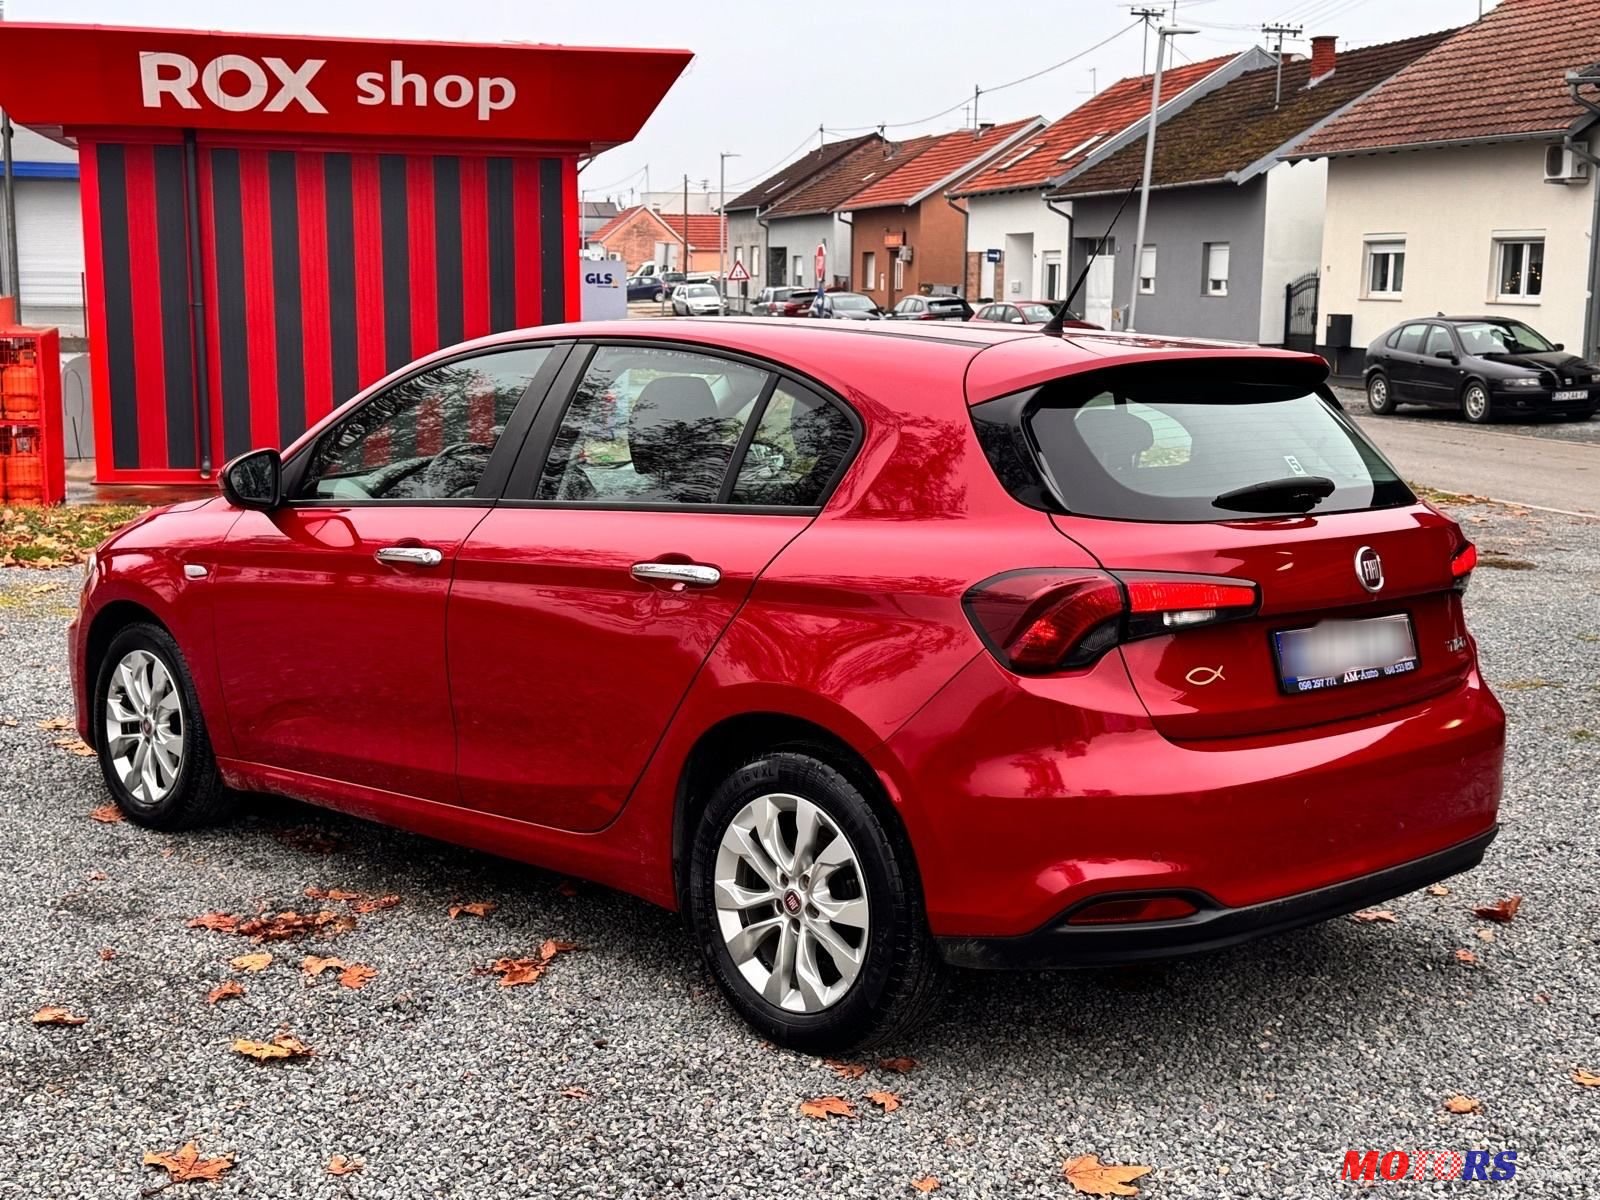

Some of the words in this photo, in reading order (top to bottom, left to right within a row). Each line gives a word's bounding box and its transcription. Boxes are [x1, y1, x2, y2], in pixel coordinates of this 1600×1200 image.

[139, 51, 329, 114] ROX
[356, 60, 516, 121] shop
[585, 273, 612, 285] GLS
[1363, 559, 1380, 580] FIAT
[786, 895, 799, 910] FIAT
